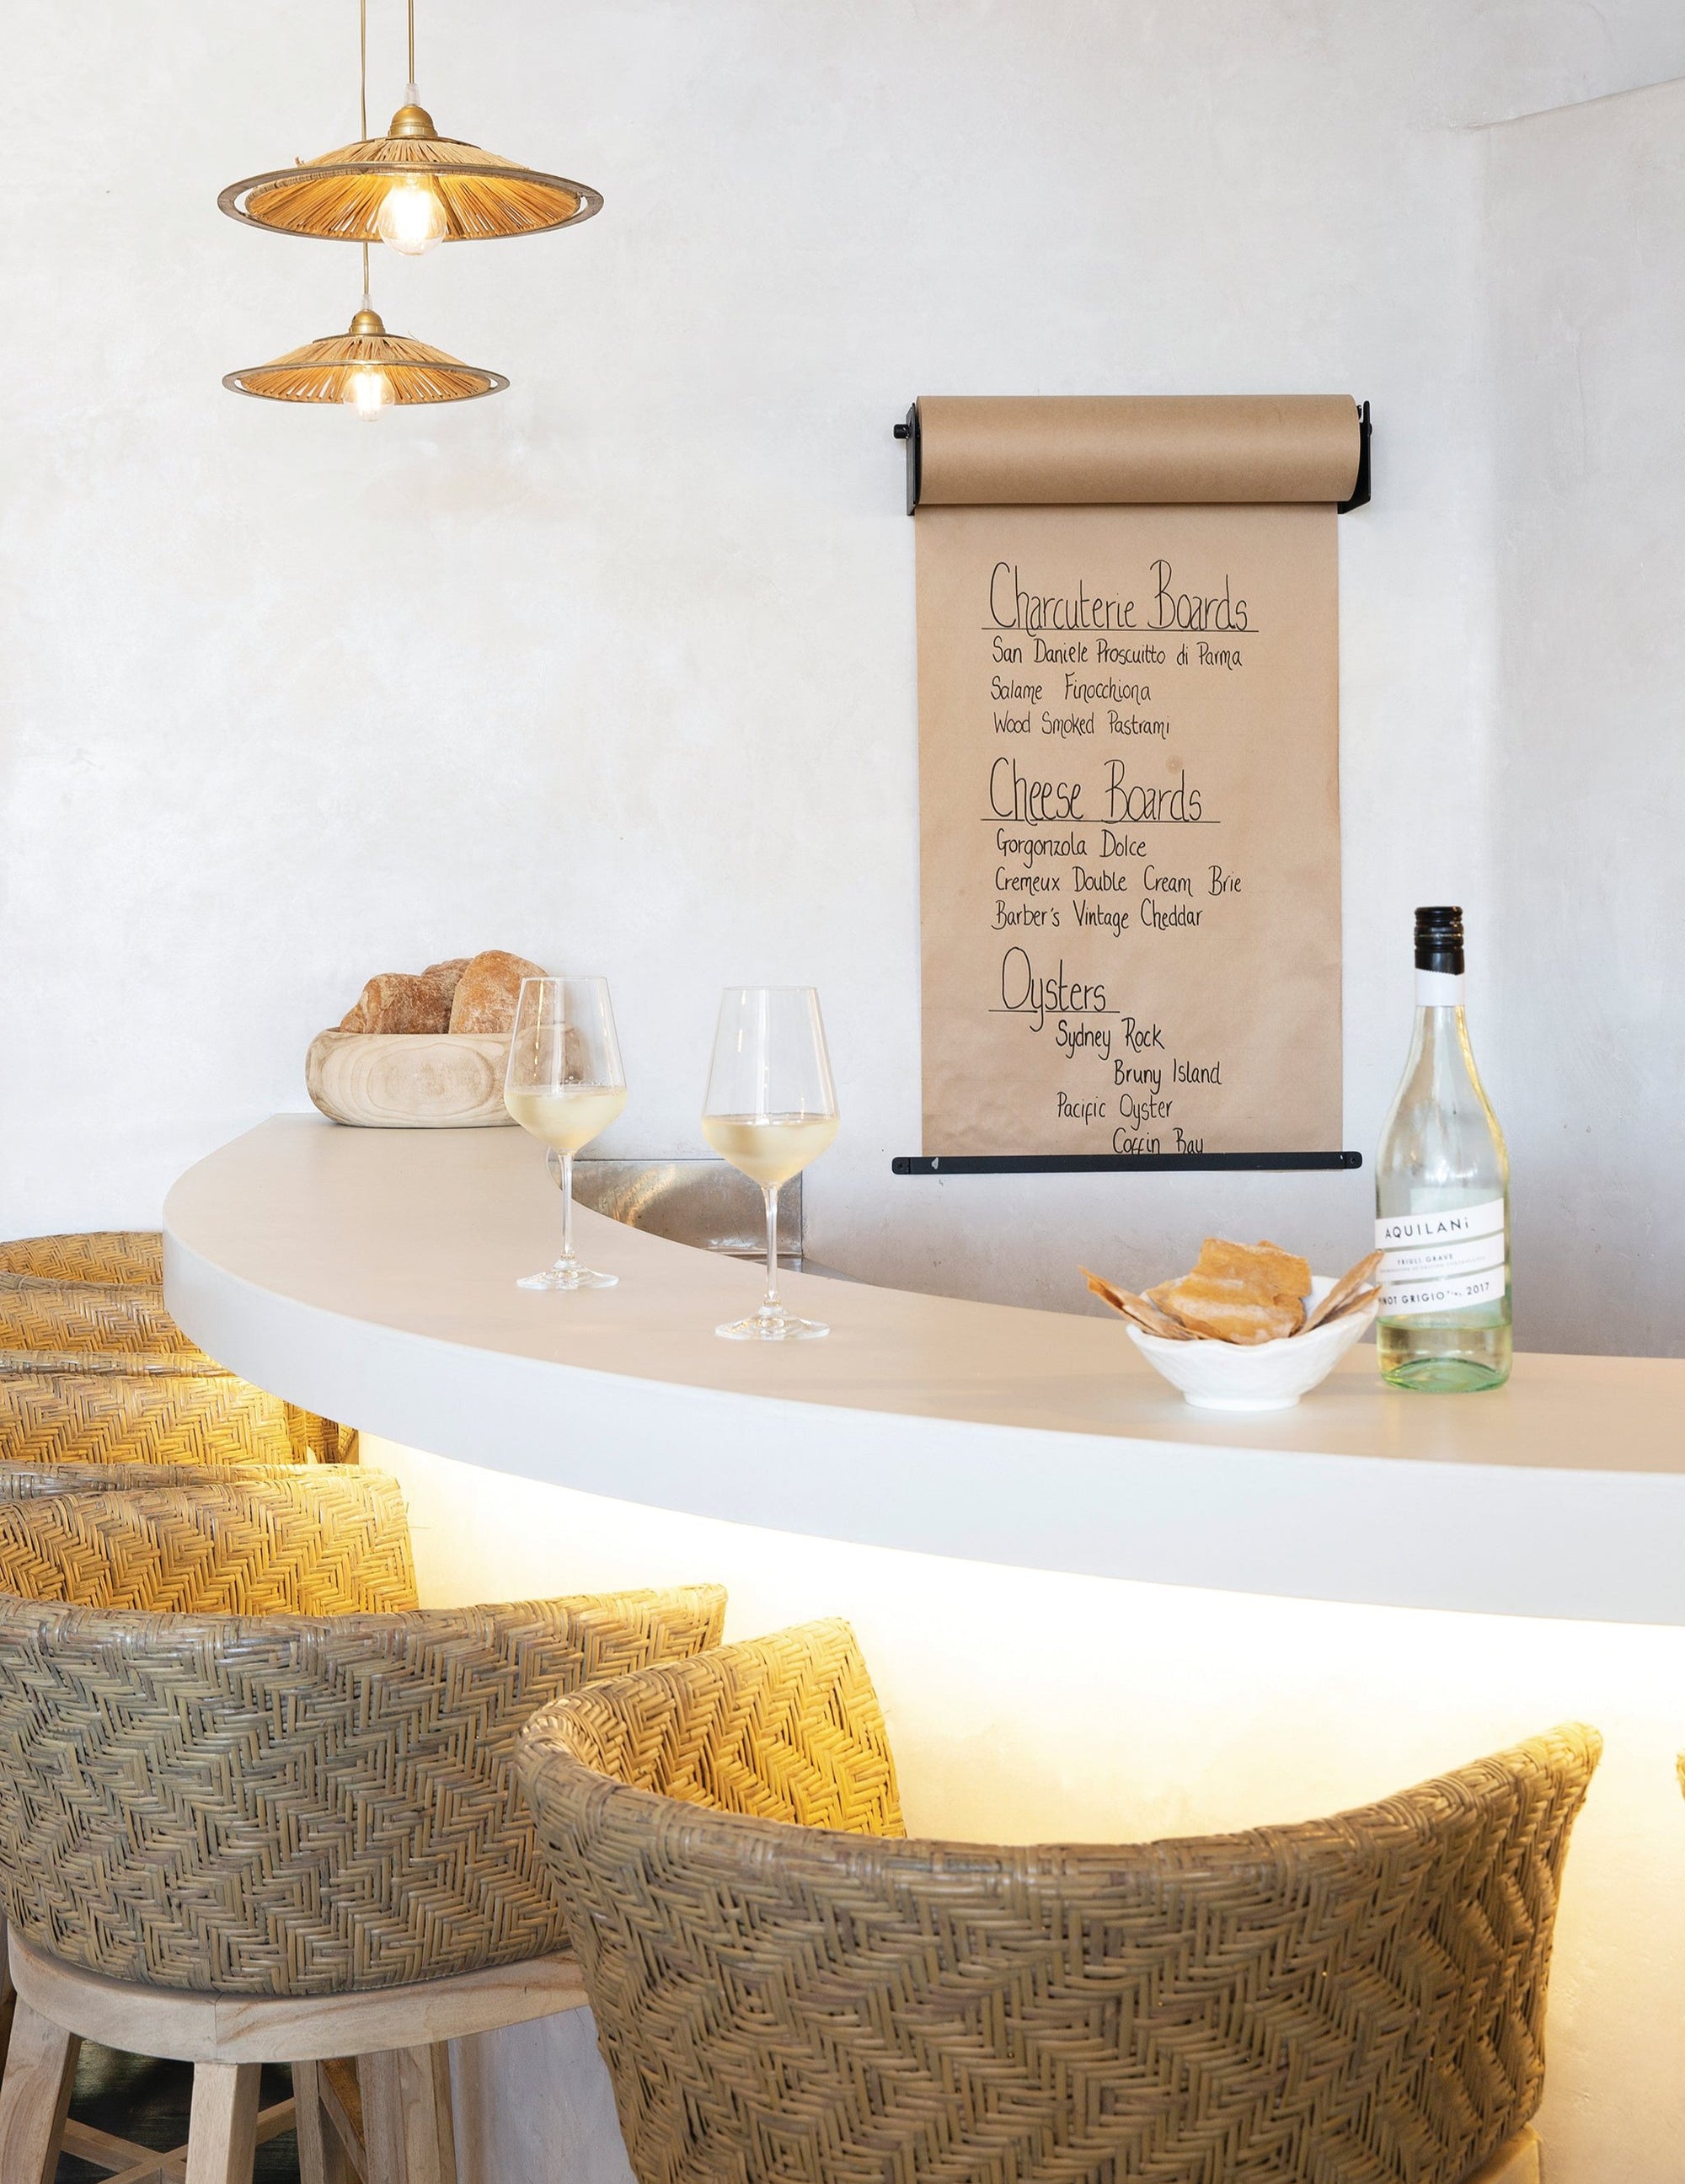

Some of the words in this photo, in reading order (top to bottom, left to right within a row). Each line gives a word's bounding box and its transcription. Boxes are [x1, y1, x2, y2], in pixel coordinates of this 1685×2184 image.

[990, 561, 1138, 637] Charcuterie
[1147, 559, 1248, 632] Boards
[992, 635, 1023, 663] San
[1033, 638, 1088, 664] Daniele
[1096, 639, 1166, 664] Proscuitto
[1177, 647, 1189, 666] di
[1196, 641, 1242, 670] Parma
[991, 676, 1043, 704] Salame
[1065, 672, 1152, 705] Finocchiona
[993, 710, 1030, 734] Wood
[1041, 711, 1094, 739] Smoked
[1107, 710, 1170, 740] Pastrami
[990, 757, 1084, 826] Cheese
[1101, 759, 1202, 824] Boards
[996, 827, 1088, 868] Gorgonzola
[1099, 829, 1147, 858] Dolce
[995, 866, 1060, 896] Cremeux
[1072, 865, 1127, 892] Double
[1144, 864, 1194, 897] Cream
[1208, 865, 1242, 896] Brie
[991, 900, 1060, 930] Barber's
[1072, 899, 1129, 937] Vintage
[1141, 898, 1203, 930] Cheddar
[1002, 946, 1106, 1032] Oysters
[1056, 1019, 1111, 1060] Sydney
[1121, 1017, 1165, 1054] Rock
[1114, 1059, 1161, 1095] Bruny
[1173, 1059, 1222, 1086] Island
[1056, 1092, 1106, 1126] Pacific
[1119, 1094, 1174, 1131] Oyster
[1113, 1127, 1160, 1154] Coffin
[1173, 1127, 1203, 1154] Bay
[1402, 1292, 1445, 1303] GRIGIO
[1466, 1282, 1490, 1295] 2017
